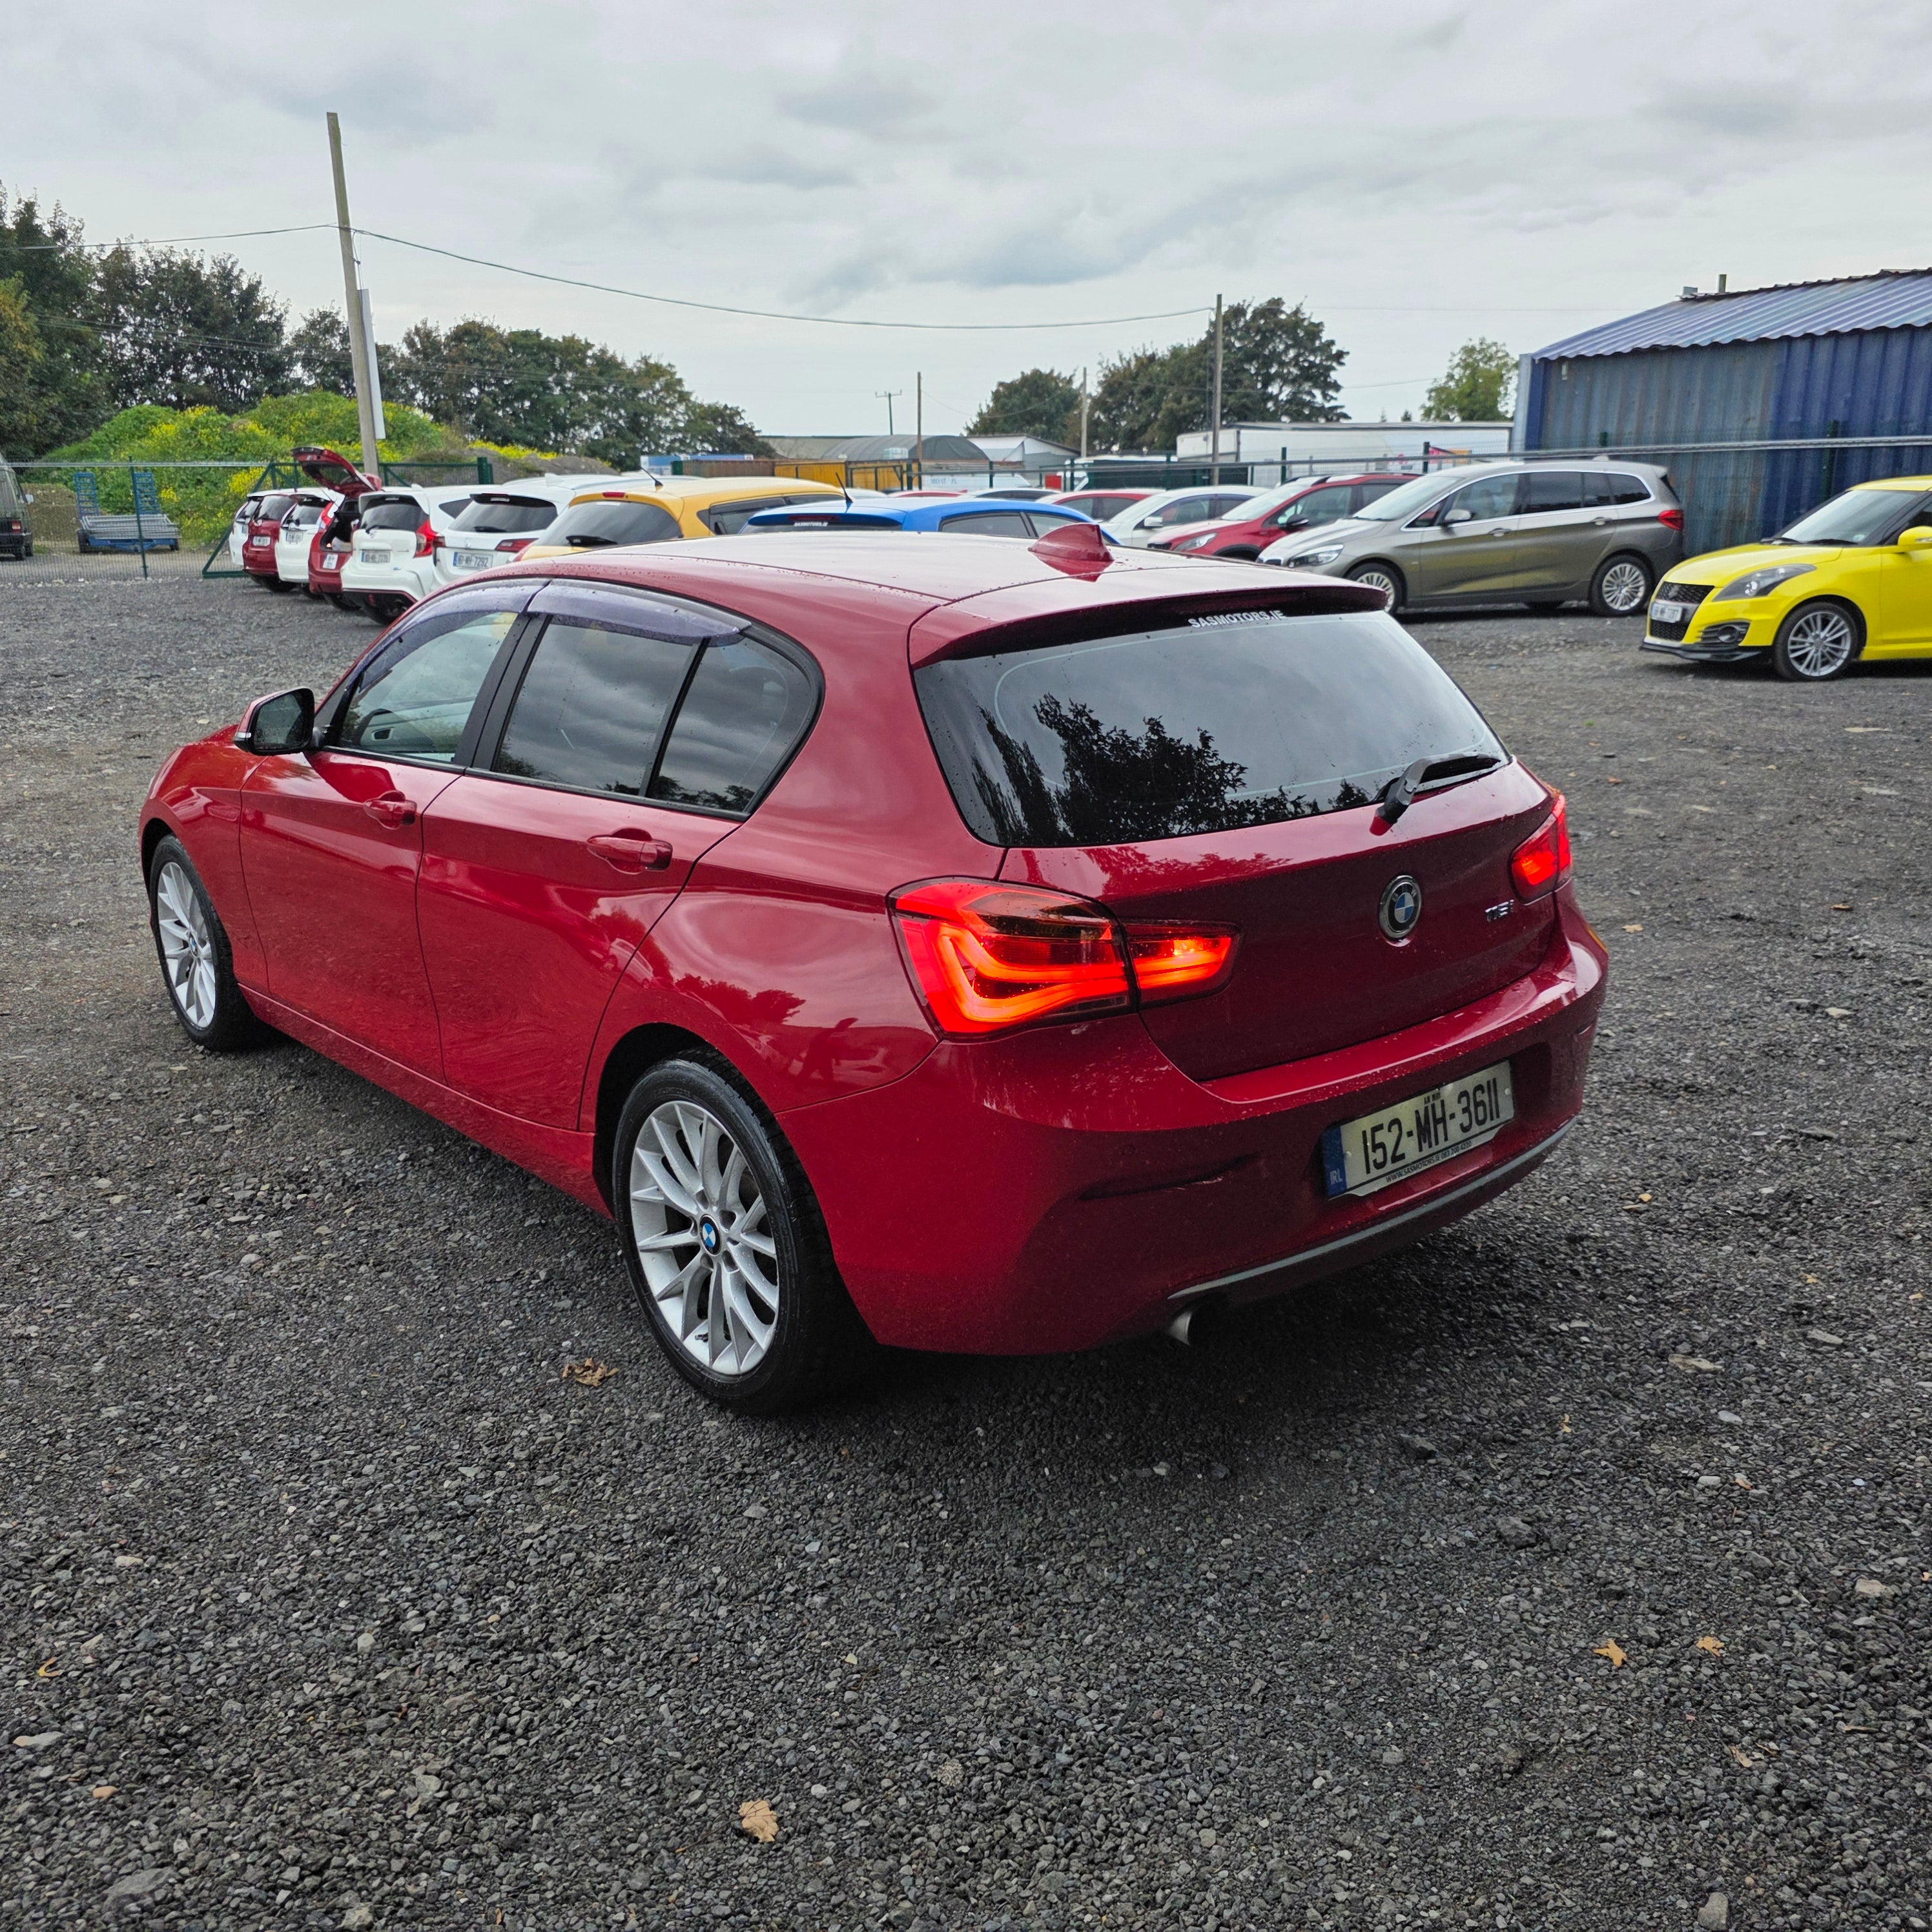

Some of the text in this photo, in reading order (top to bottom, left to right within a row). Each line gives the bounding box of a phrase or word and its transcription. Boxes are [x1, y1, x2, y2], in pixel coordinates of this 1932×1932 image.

[1188, 610, 1287, 628] SASMOTORS.IE
[1362, 1077, 1500, 1175] 152-MH-3611
[1330, 1168, 1343, 1185] IRL
